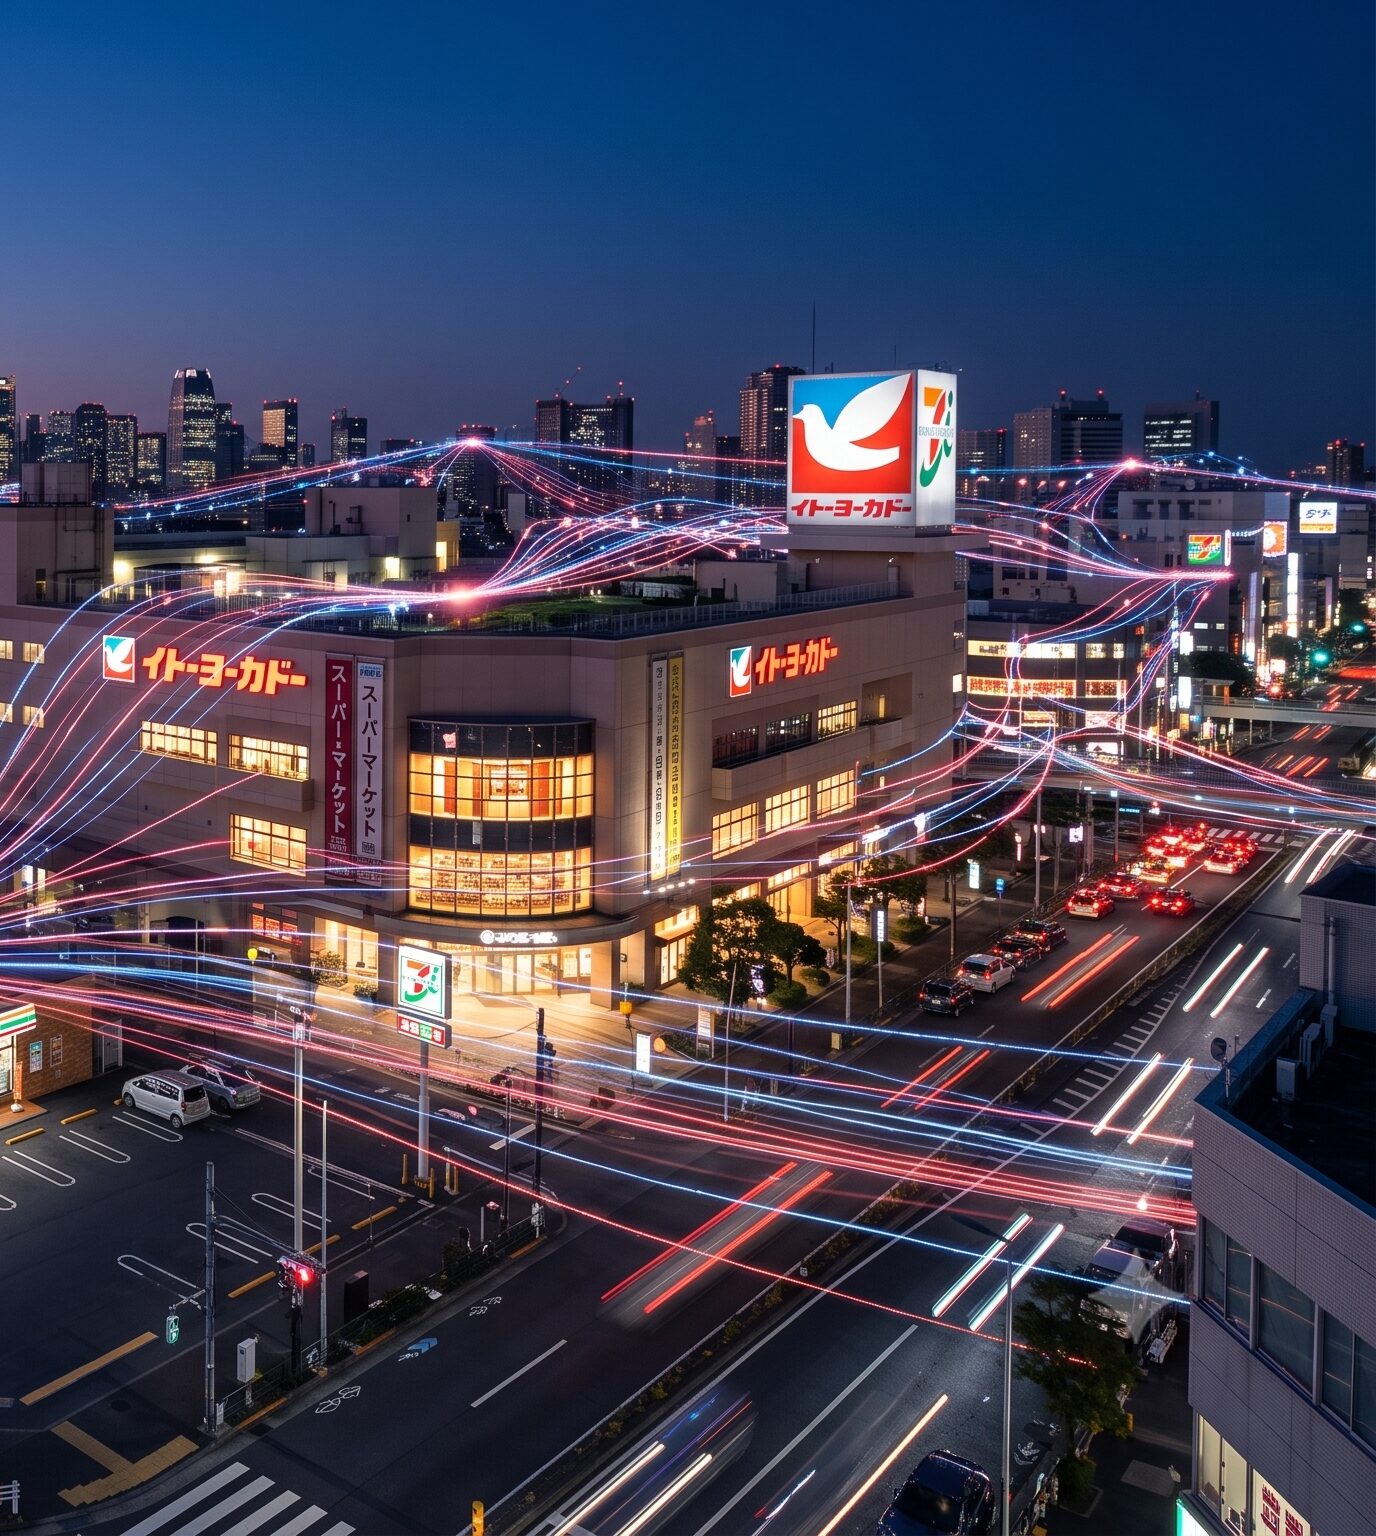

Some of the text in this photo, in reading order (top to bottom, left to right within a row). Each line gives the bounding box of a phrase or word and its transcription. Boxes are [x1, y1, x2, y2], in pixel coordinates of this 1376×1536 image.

[791, 499, 912, 518] イトーヨーカドー
[141, 645, 308, 696] イトーヨーカドー
[754, 636, 839, 686] イトーヨーカドー
[361, 685, 378, 838] スーパーマーケット
